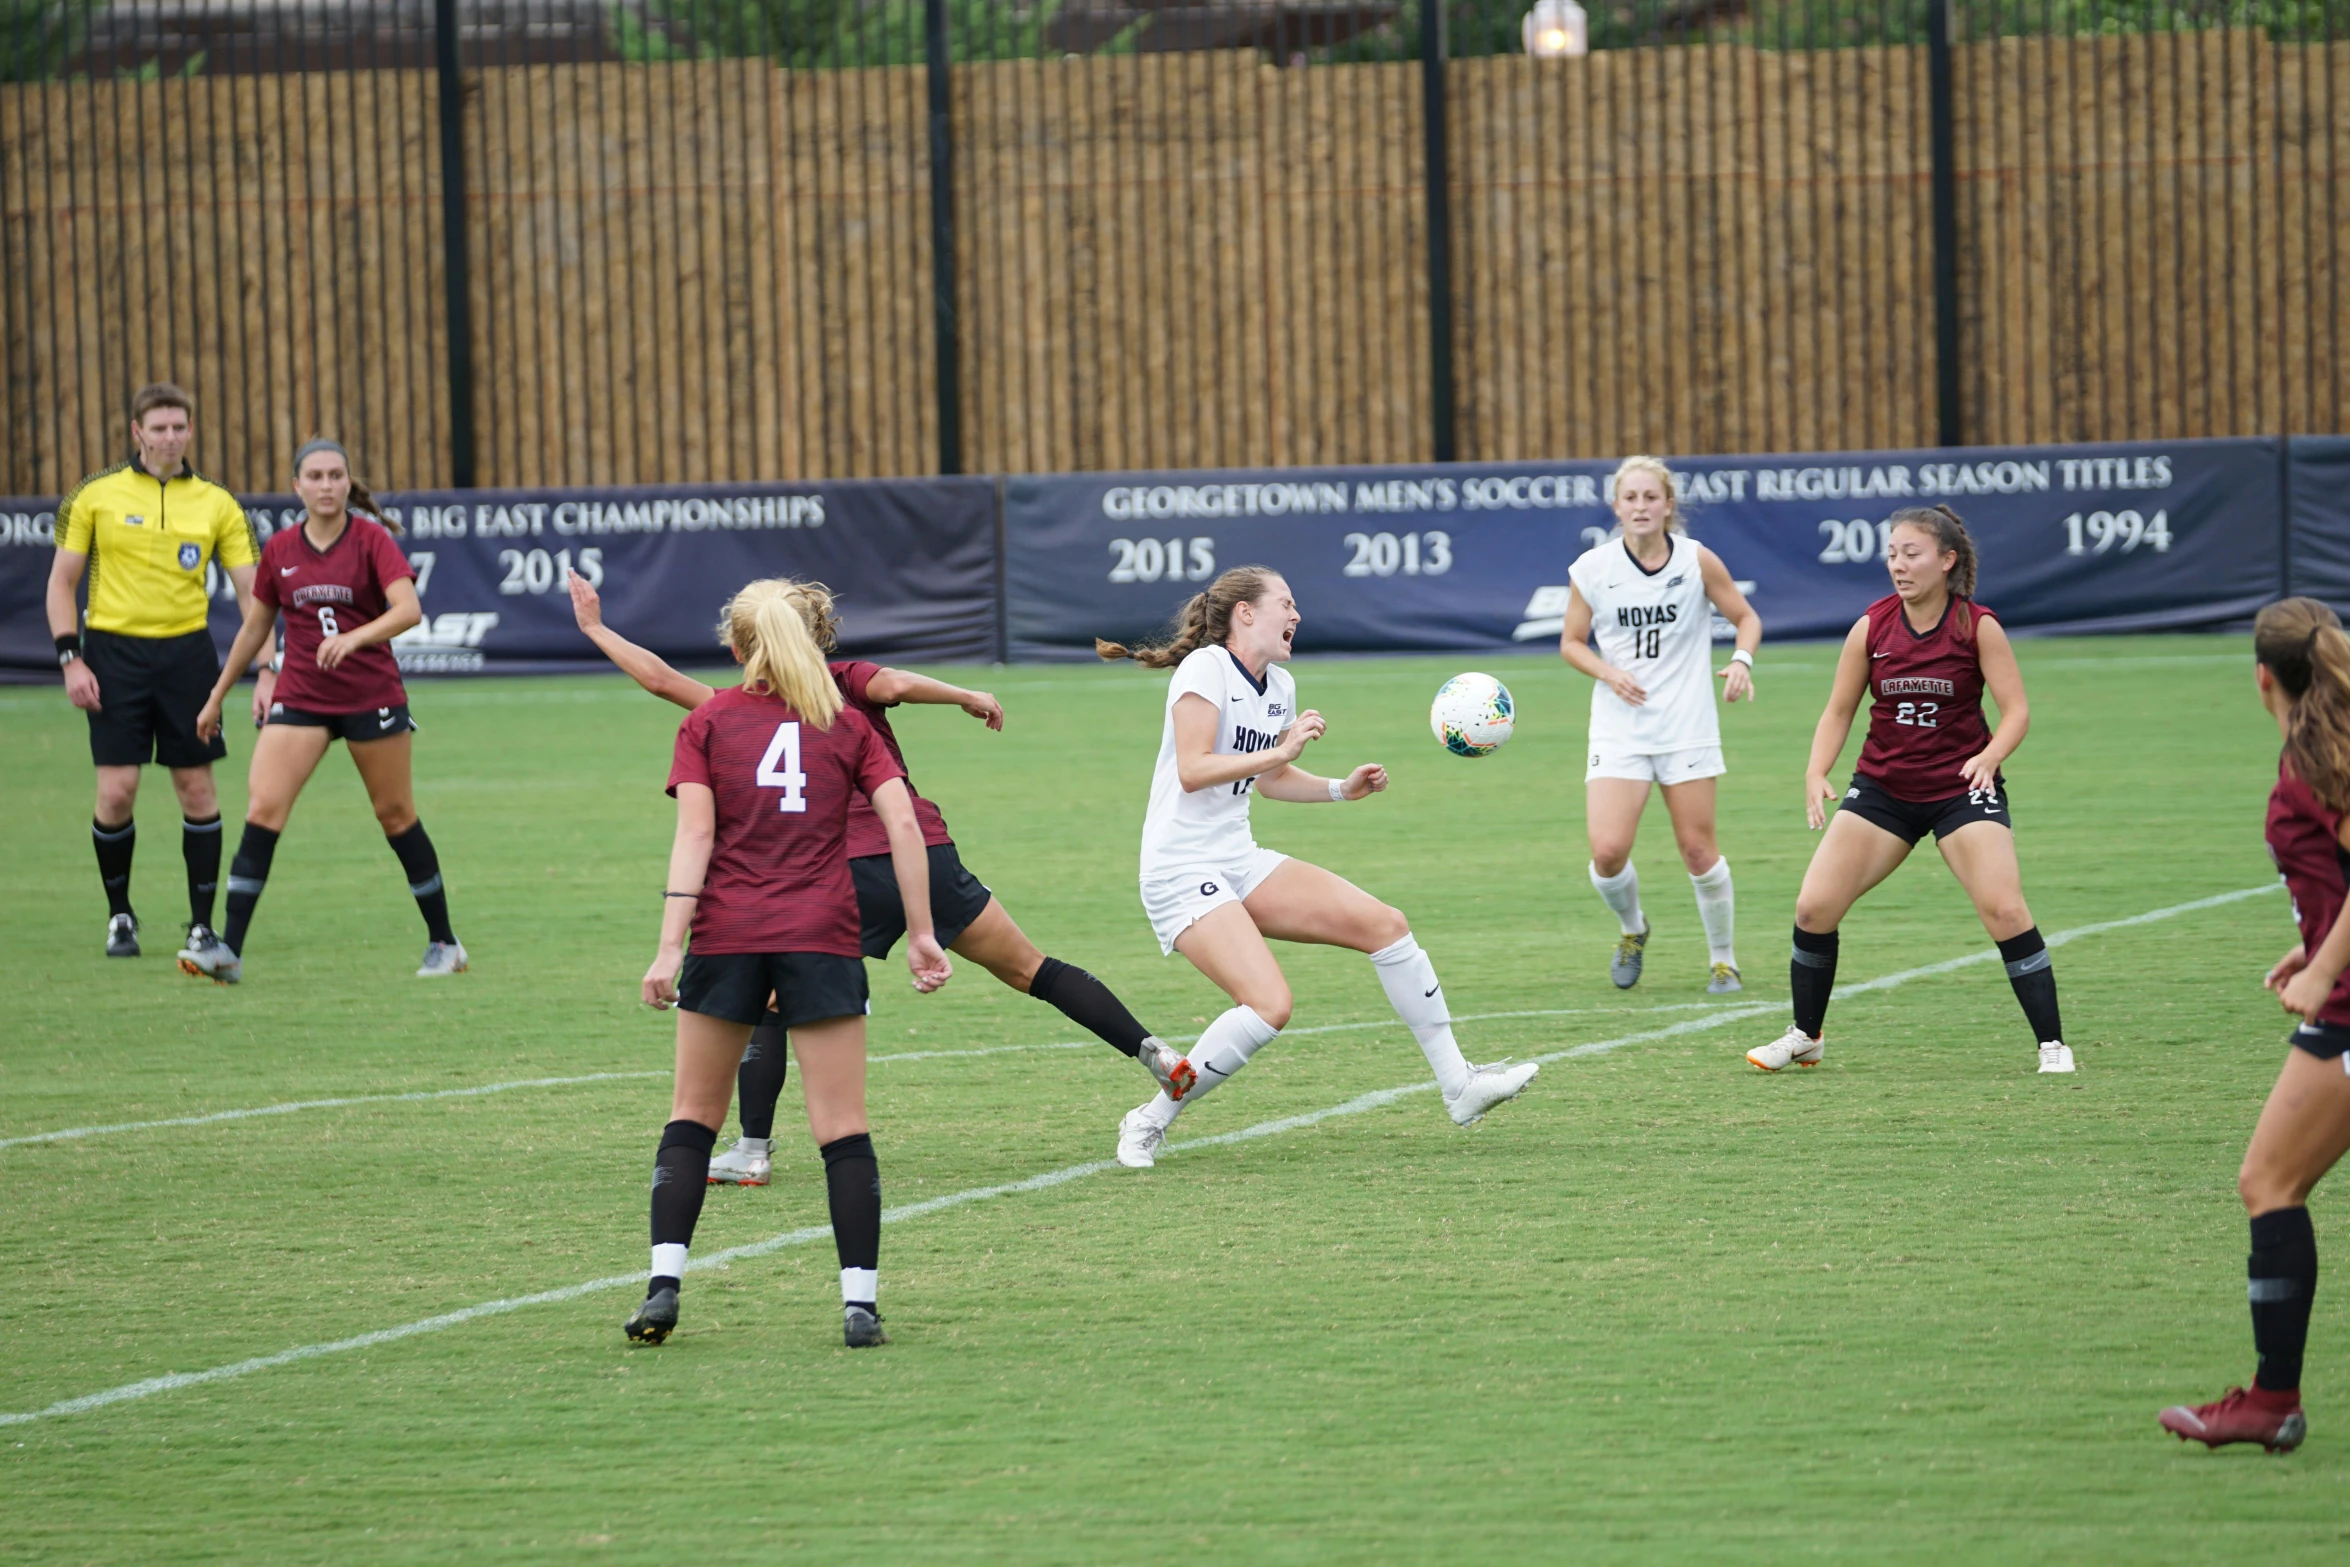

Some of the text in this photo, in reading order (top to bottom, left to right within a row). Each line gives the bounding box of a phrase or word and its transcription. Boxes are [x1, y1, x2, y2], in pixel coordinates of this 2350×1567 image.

[1102, 482, 1348, 520] GEORGETOWN
[1355, 477, 1457, 513] MEN'S
[1462, 475, 1598, 510] SOCCER
[1756, 465, 1915, 500] REGULAR
[1918, 460, 2049, 496] SEASON
[2055, 455, 2173, 491] TITLES
[412, 505, 467, 539] BIG
[475, 503, 549, 538] EAST
[553, 495, 825, 536] CHAMPIONSHIPS
[1108, 508, 2173, 583] 2015 2013 201 1994
[499, 547, 604, 594] 2015
[318, 606, 339, 637] 6
[1618, 604, 1678, 627] HOYAS
[1635, 629, 1660, 659] 10
[1882, 677, 1954, 696] LAFAYETTE
[1896, 702, 1939, 728] 22
[756, 721, 807, 812] 4
